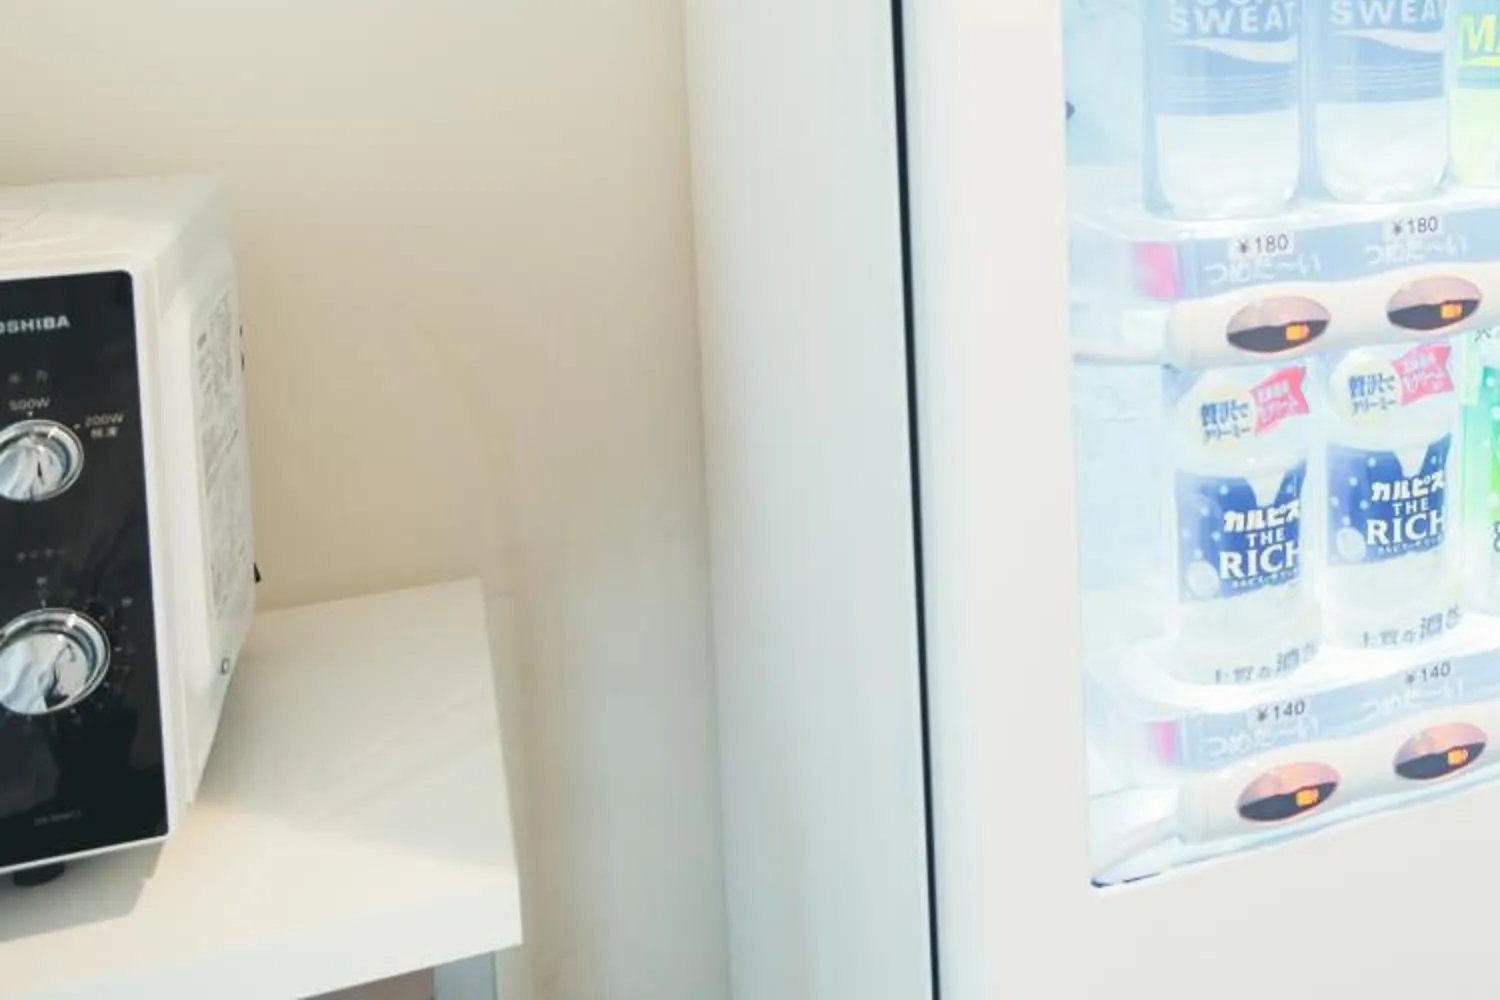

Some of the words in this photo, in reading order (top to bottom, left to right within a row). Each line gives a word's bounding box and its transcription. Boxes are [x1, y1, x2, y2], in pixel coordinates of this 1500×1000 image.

[1166, 1, 1297, 36] SWEAT
[1391, 214, 1440, 236] ¥180
[1236, 232, 1290, 255] ¥180
[1391, 499, 1430, 517] THE
[1246, 530, 1285, 547] THE
[1404, 660, 1452, 686] ¥140
[1255, 698, 1306, 723] ¥140
